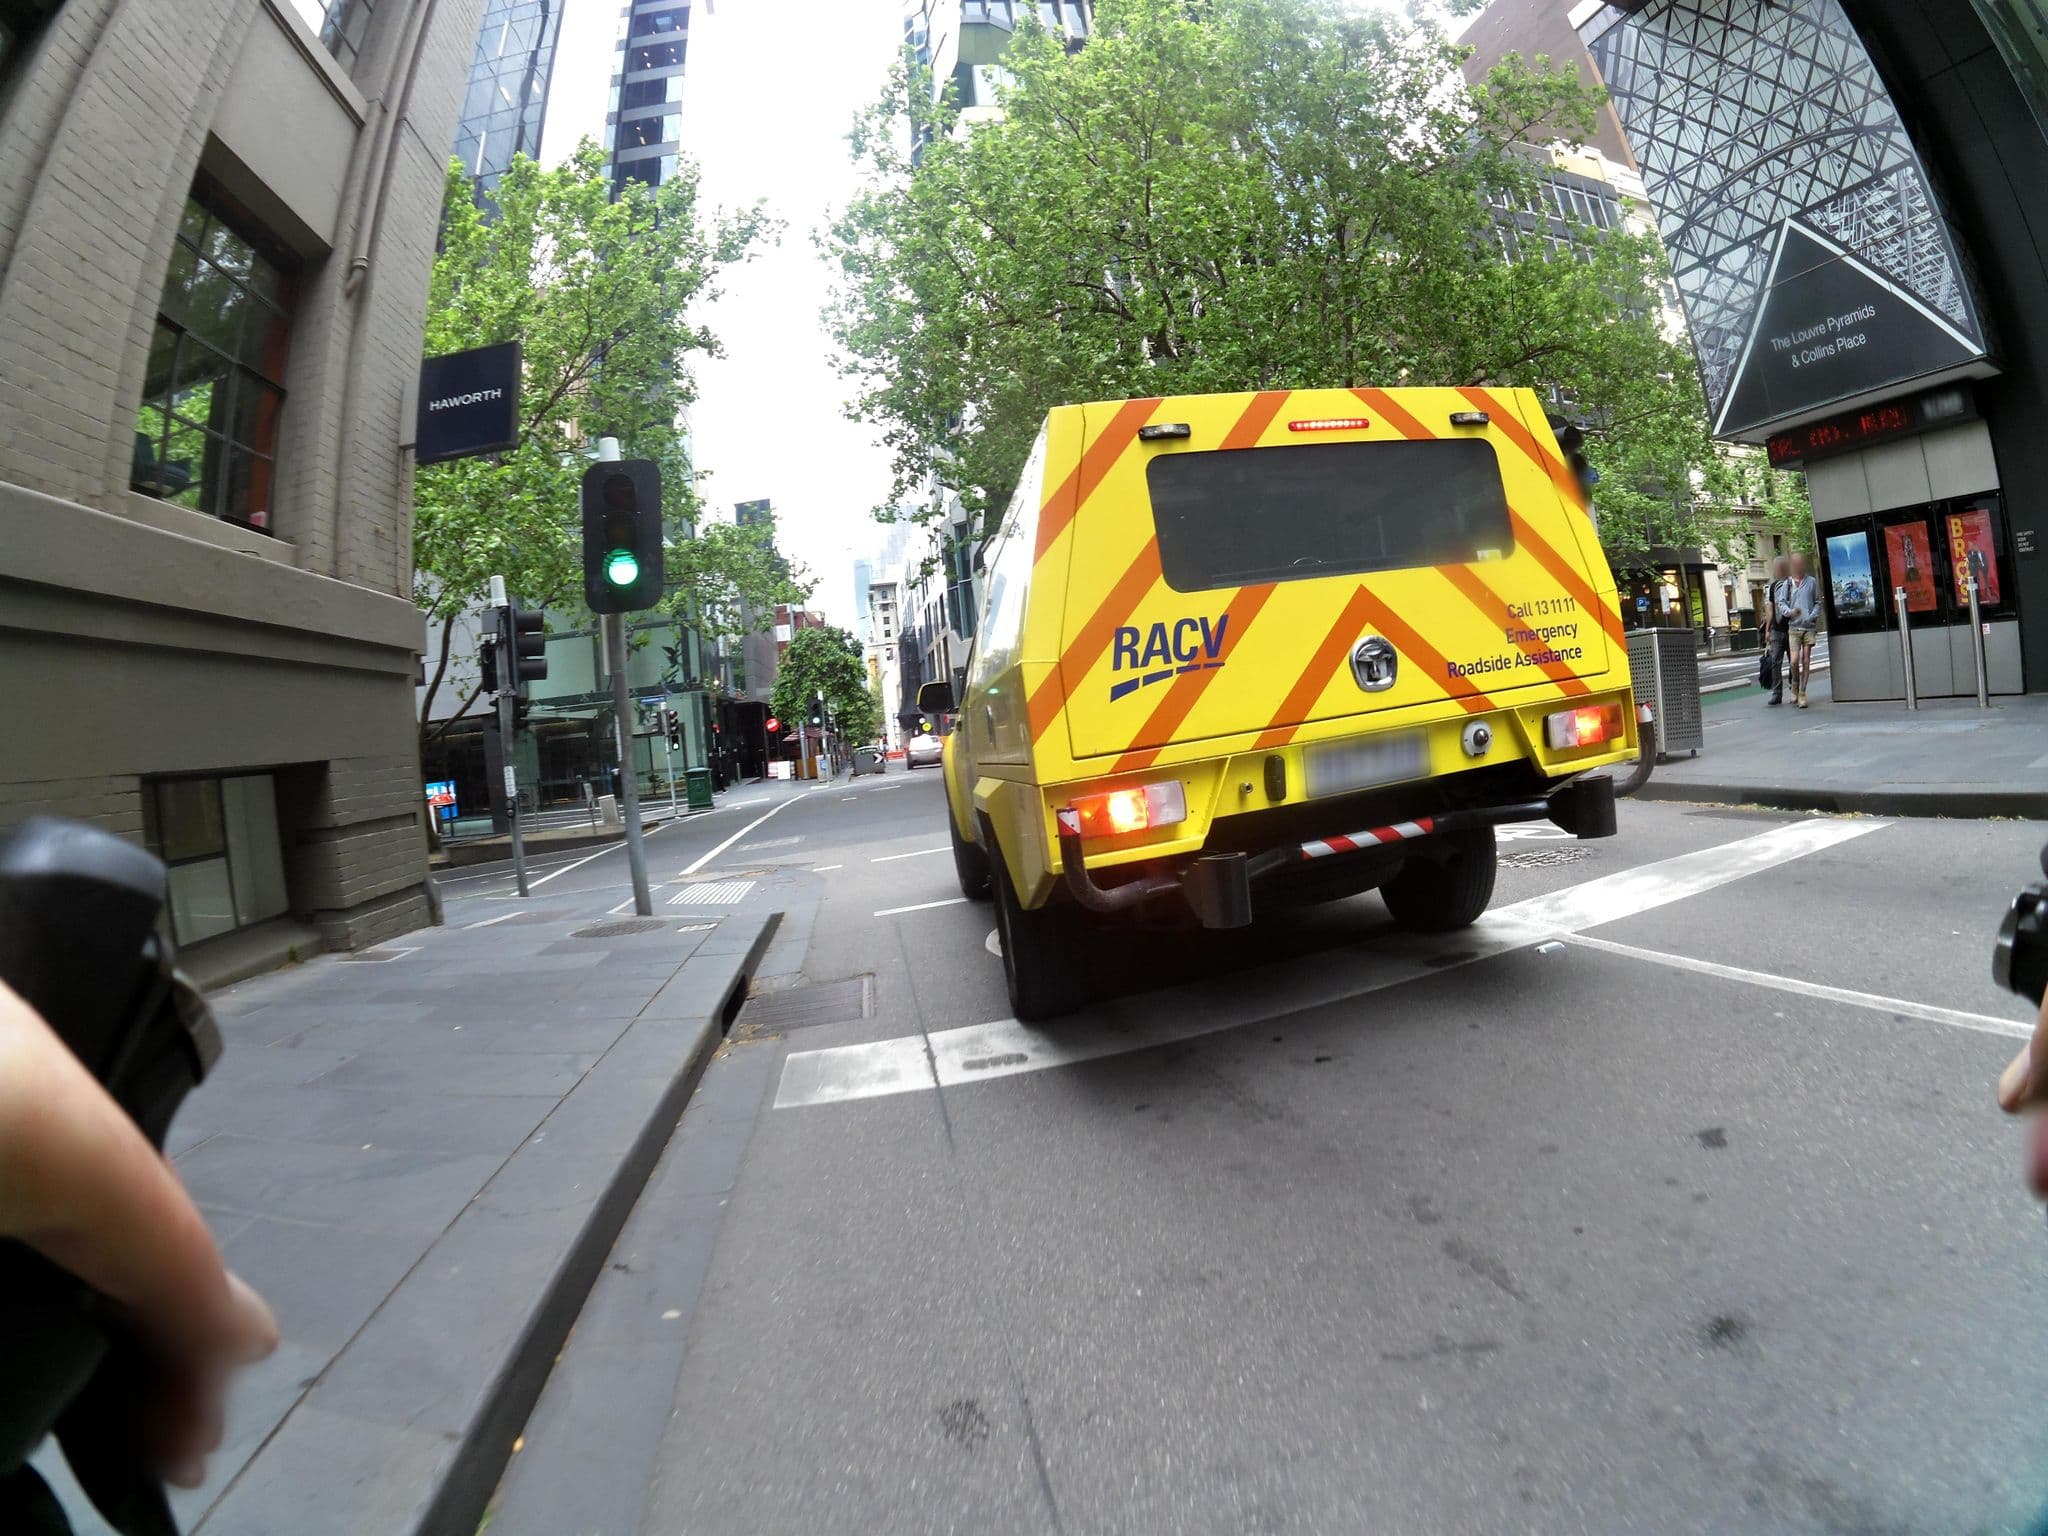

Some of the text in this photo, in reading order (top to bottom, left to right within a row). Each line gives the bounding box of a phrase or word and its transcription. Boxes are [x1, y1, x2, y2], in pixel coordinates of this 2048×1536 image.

[1770, 304, 1876, 352] The Louvre Pyramids
[1792, 333, 1866, 368] & Collins Place
[429, 388, 502, 411] HAWORTH
[1507, 602, 1533, 619] Call
[1112, 614, 1229, 671] RACV
[1505, 623, 1578, 644] Emergency
[1447, 646, 1582, 679] Roadside Assistance
